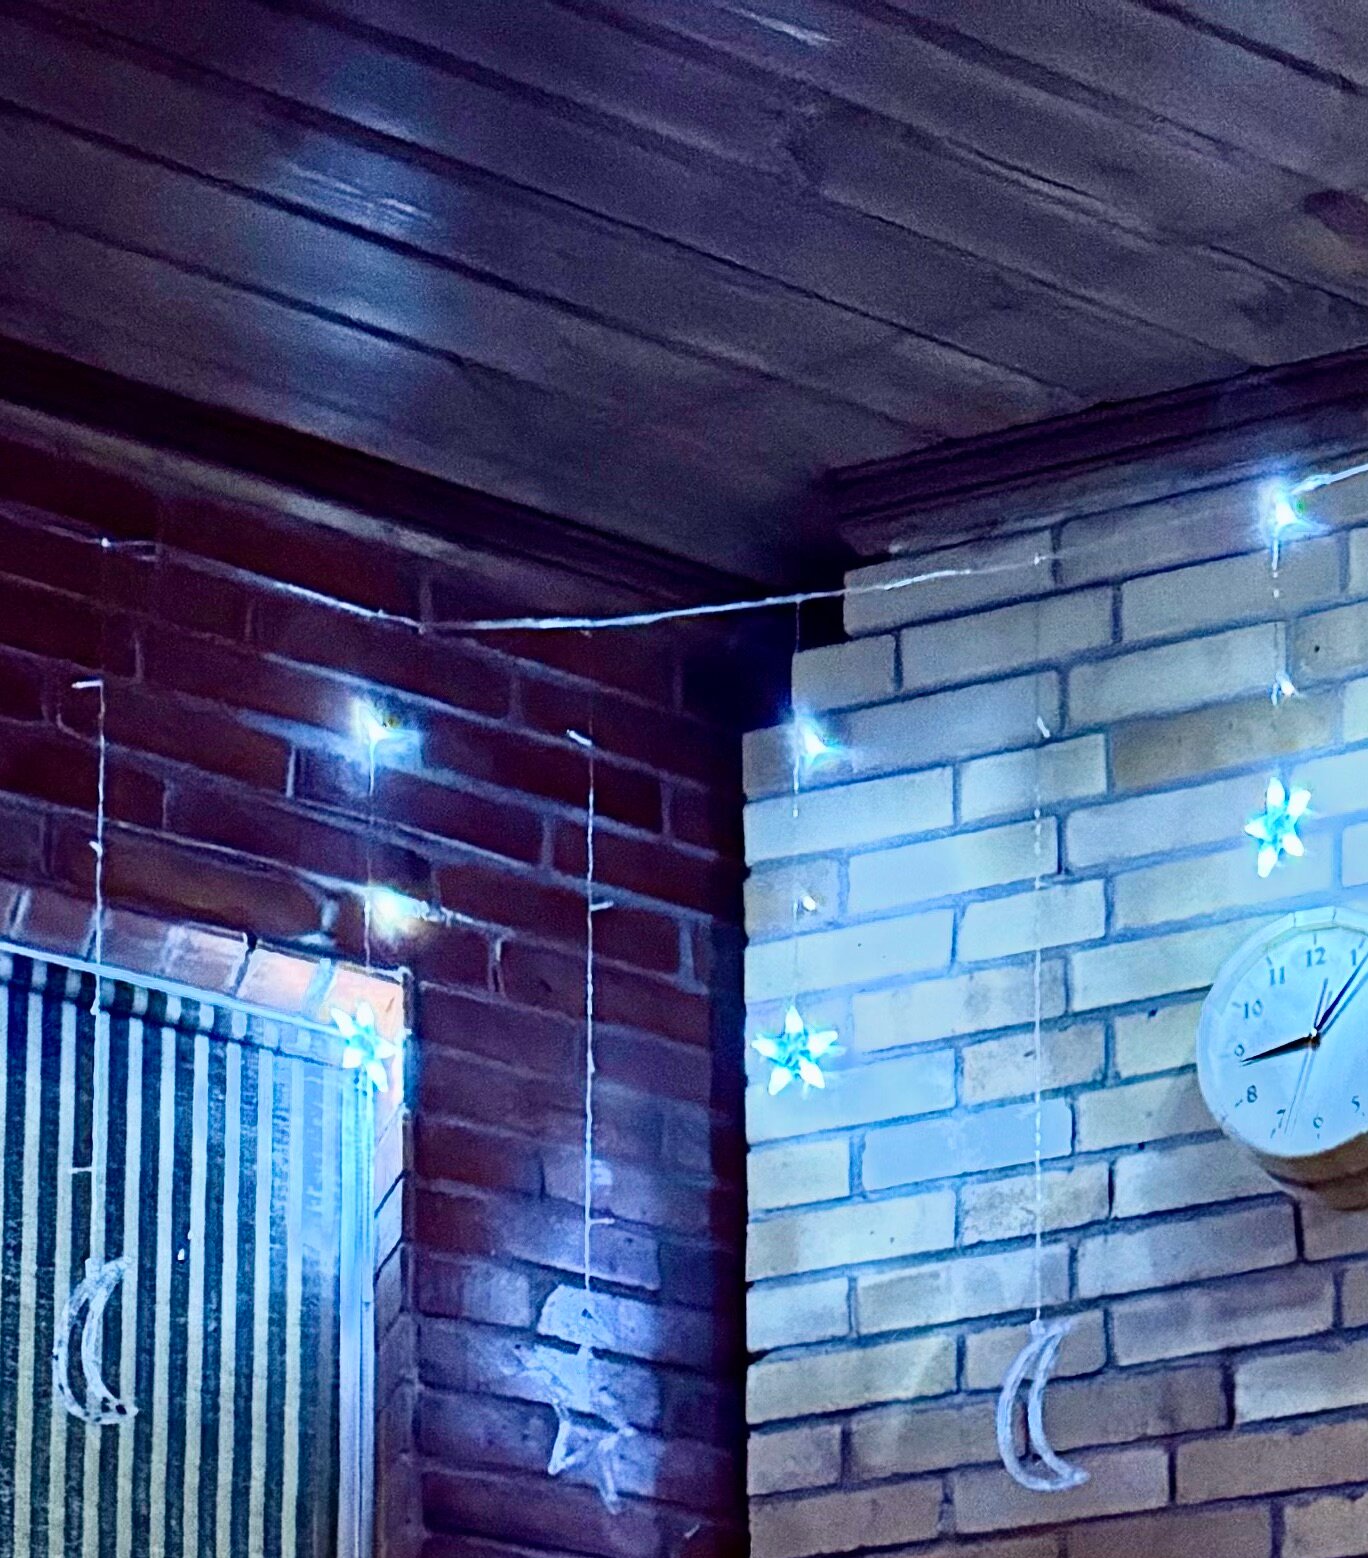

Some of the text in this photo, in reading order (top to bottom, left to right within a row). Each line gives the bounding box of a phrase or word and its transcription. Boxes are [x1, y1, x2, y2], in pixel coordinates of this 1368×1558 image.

[1306, 946, 1326, 967] 12
[1351, 948, 1357, 966] 1
[1269, 966, 1285, 986] 11
[1244, 998, 1263, 1019] 10
[1246, 1084, 1258, 1103] 8
[1351, 1095, 1361, 1113] 5
[1276, 1109, 1286, 1129] 7
